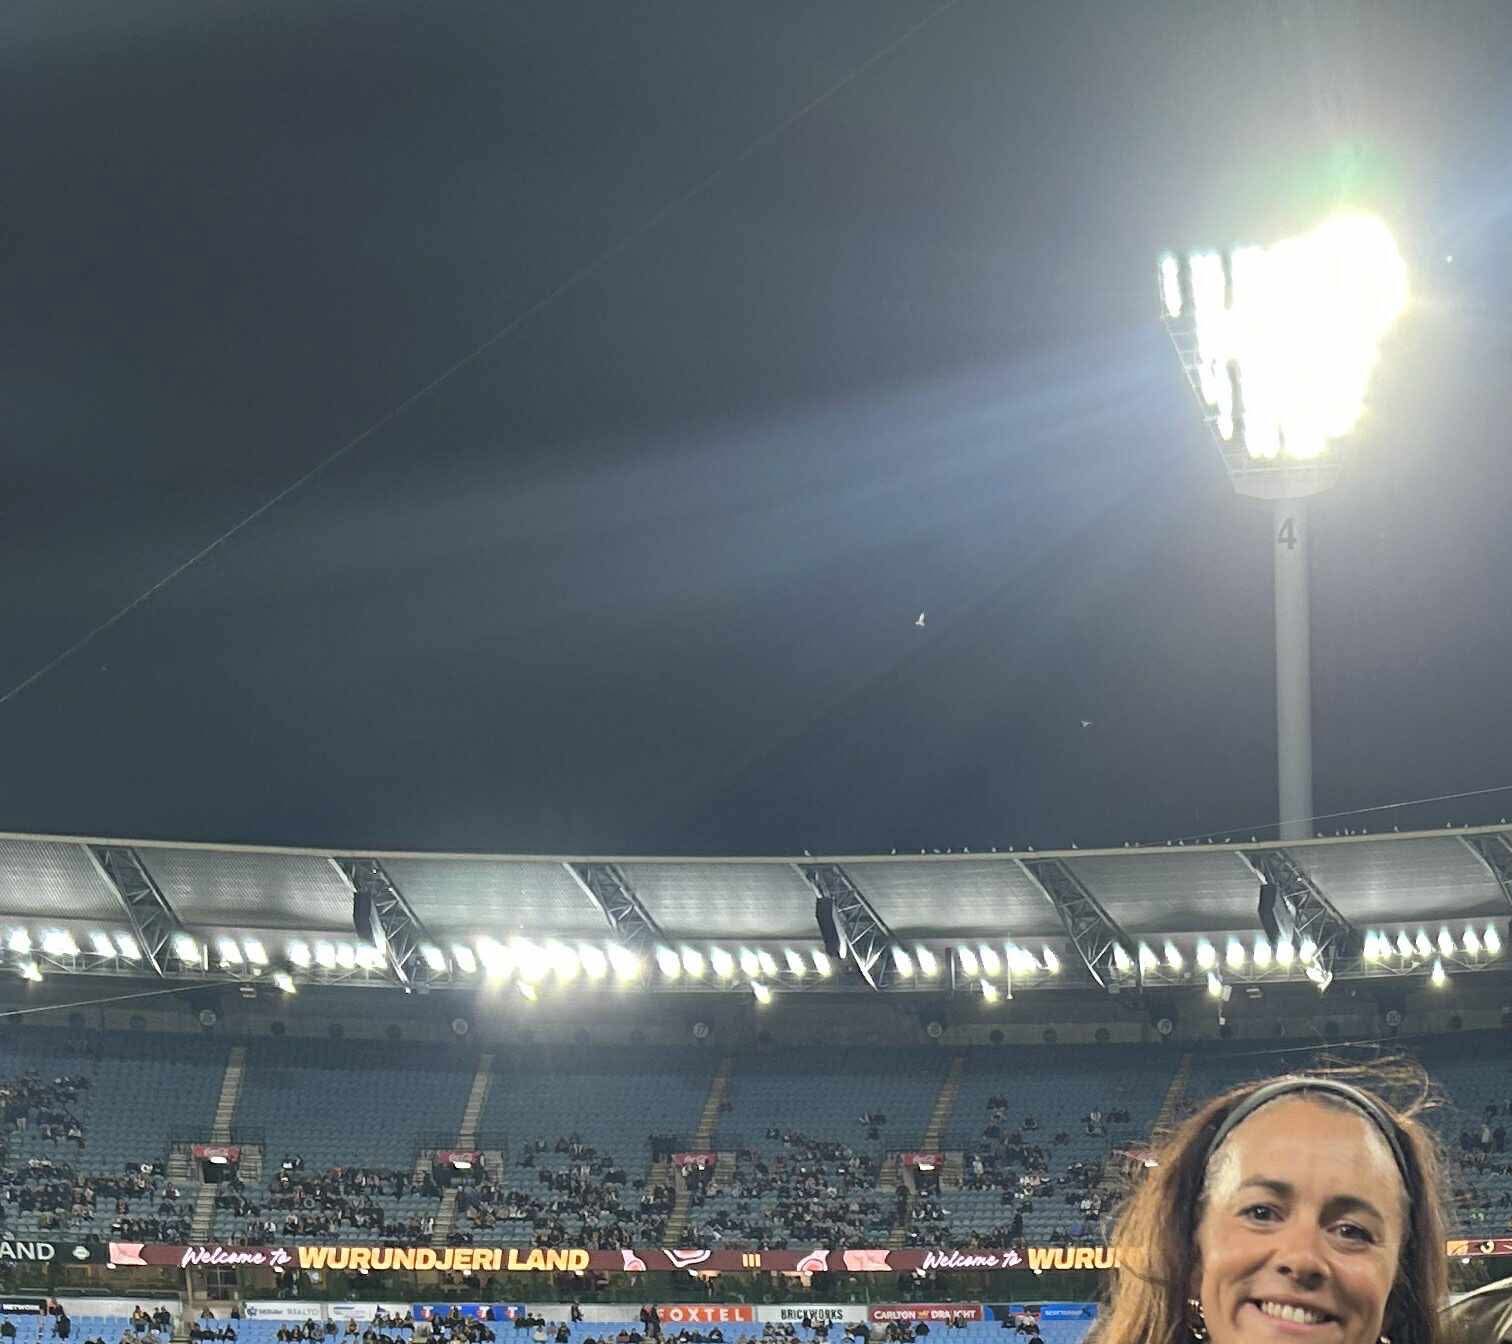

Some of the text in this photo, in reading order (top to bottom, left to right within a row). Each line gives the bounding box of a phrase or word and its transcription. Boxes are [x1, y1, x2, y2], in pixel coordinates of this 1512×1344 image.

[1277, 517, 1297, 550] 4
[181, 1246, 590, 1271] Welcome to WURUNDJERI LAND
[922, 1250, 999, 1269] Welcome
[1001, 1250, 1022, 1268] to
[873, 1310, 916, 1320] CARLTON
